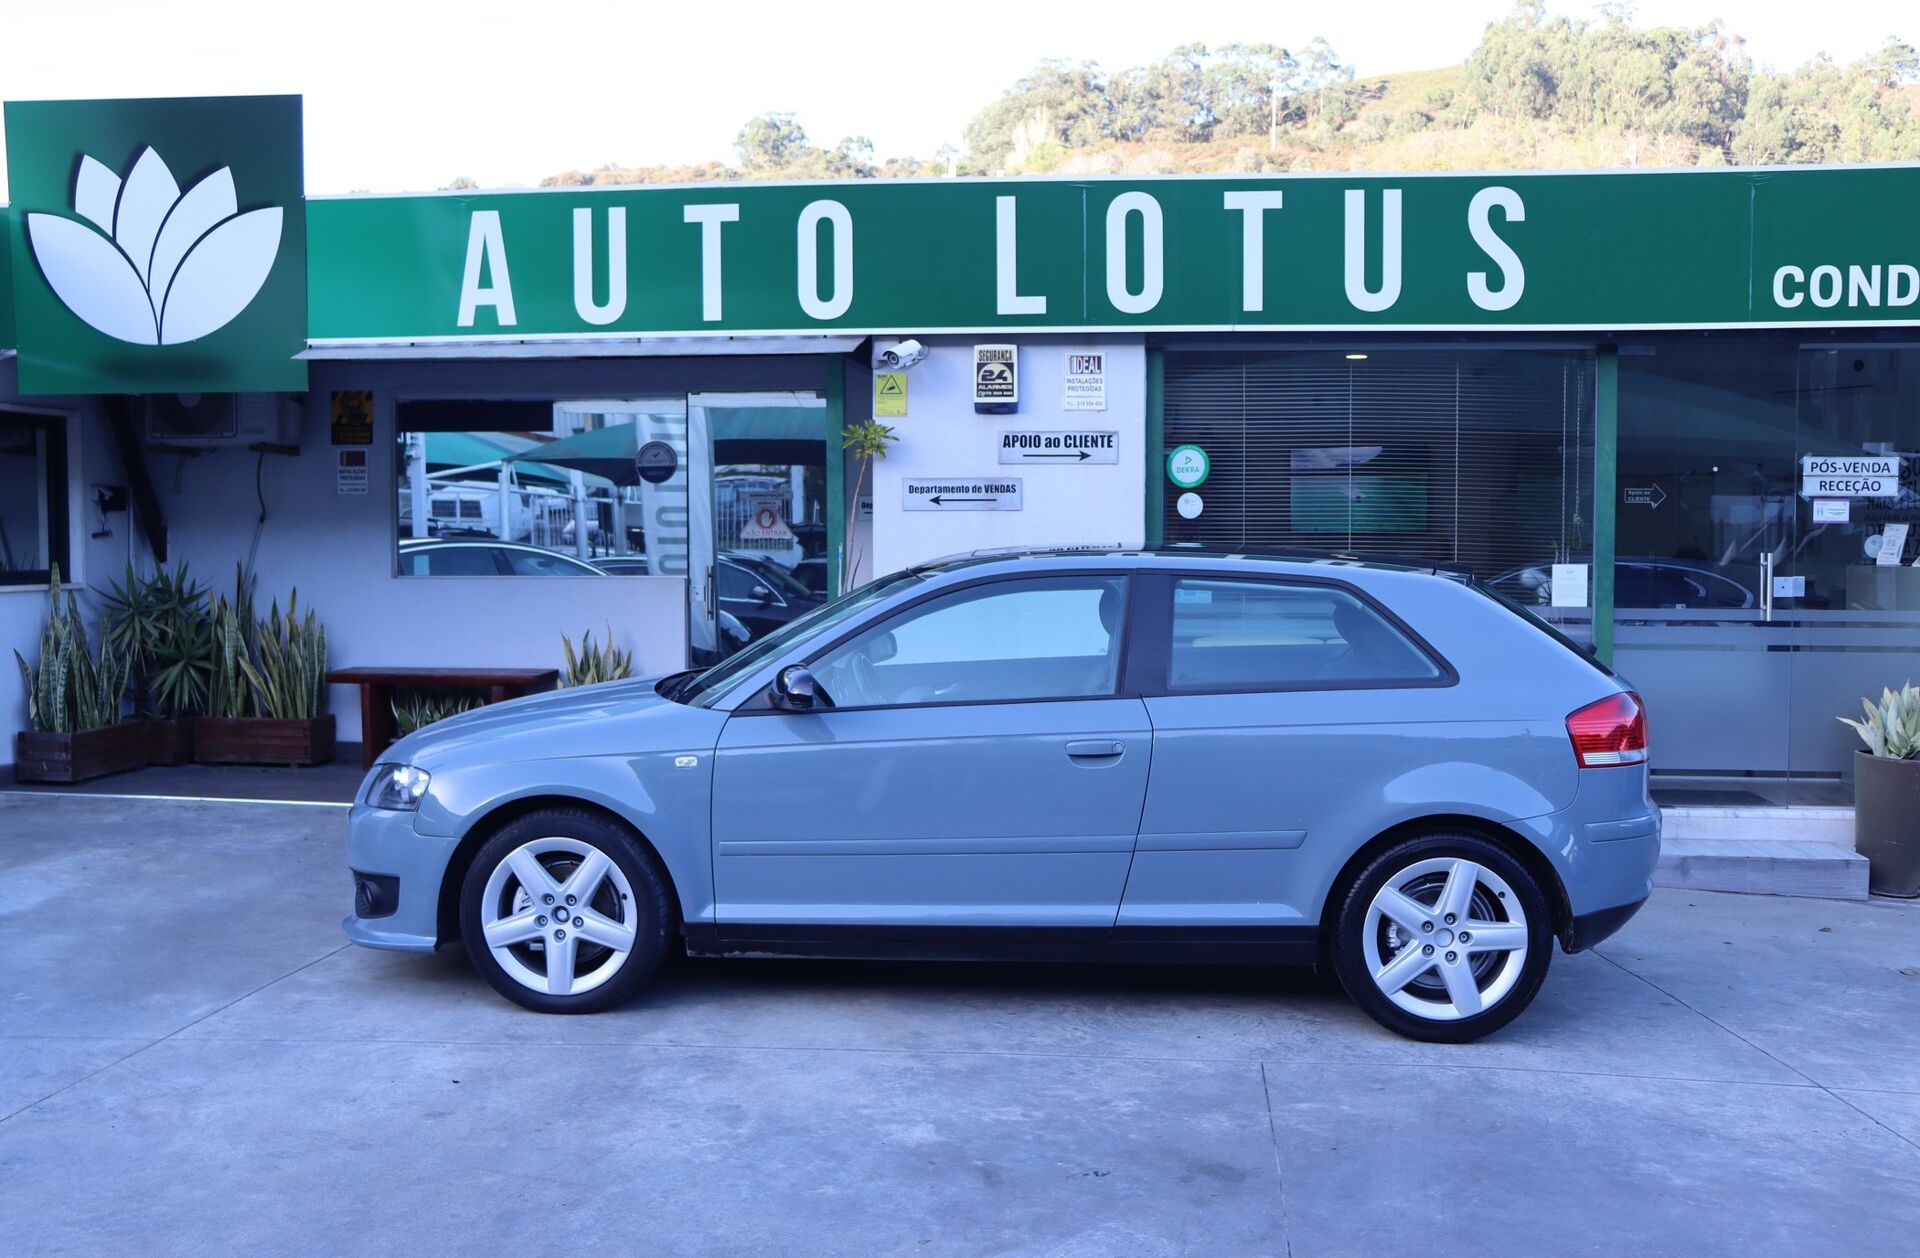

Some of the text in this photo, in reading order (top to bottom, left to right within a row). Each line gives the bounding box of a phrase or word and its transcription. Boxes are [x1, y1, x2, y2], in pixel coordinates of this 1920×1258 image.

[457, 186, 1526, 327] AUTO LOTUS
[1772, 264, 1920, 308] COND
[1070, 356, 1101, 374] IDEAL
[981, 369, 1008, 382] 24
[1066, 377, 1103, 385] INSTALAÇÕES
[1003, 435, 1114, 448] APOIO ao CLIENTE
[1810, 459, 1891, 473] PÓS-VENDA
[908, 484, 1017, 495] Departamento de VENDAS
[1819, 478, 1882, 494] RECEÇÃO
